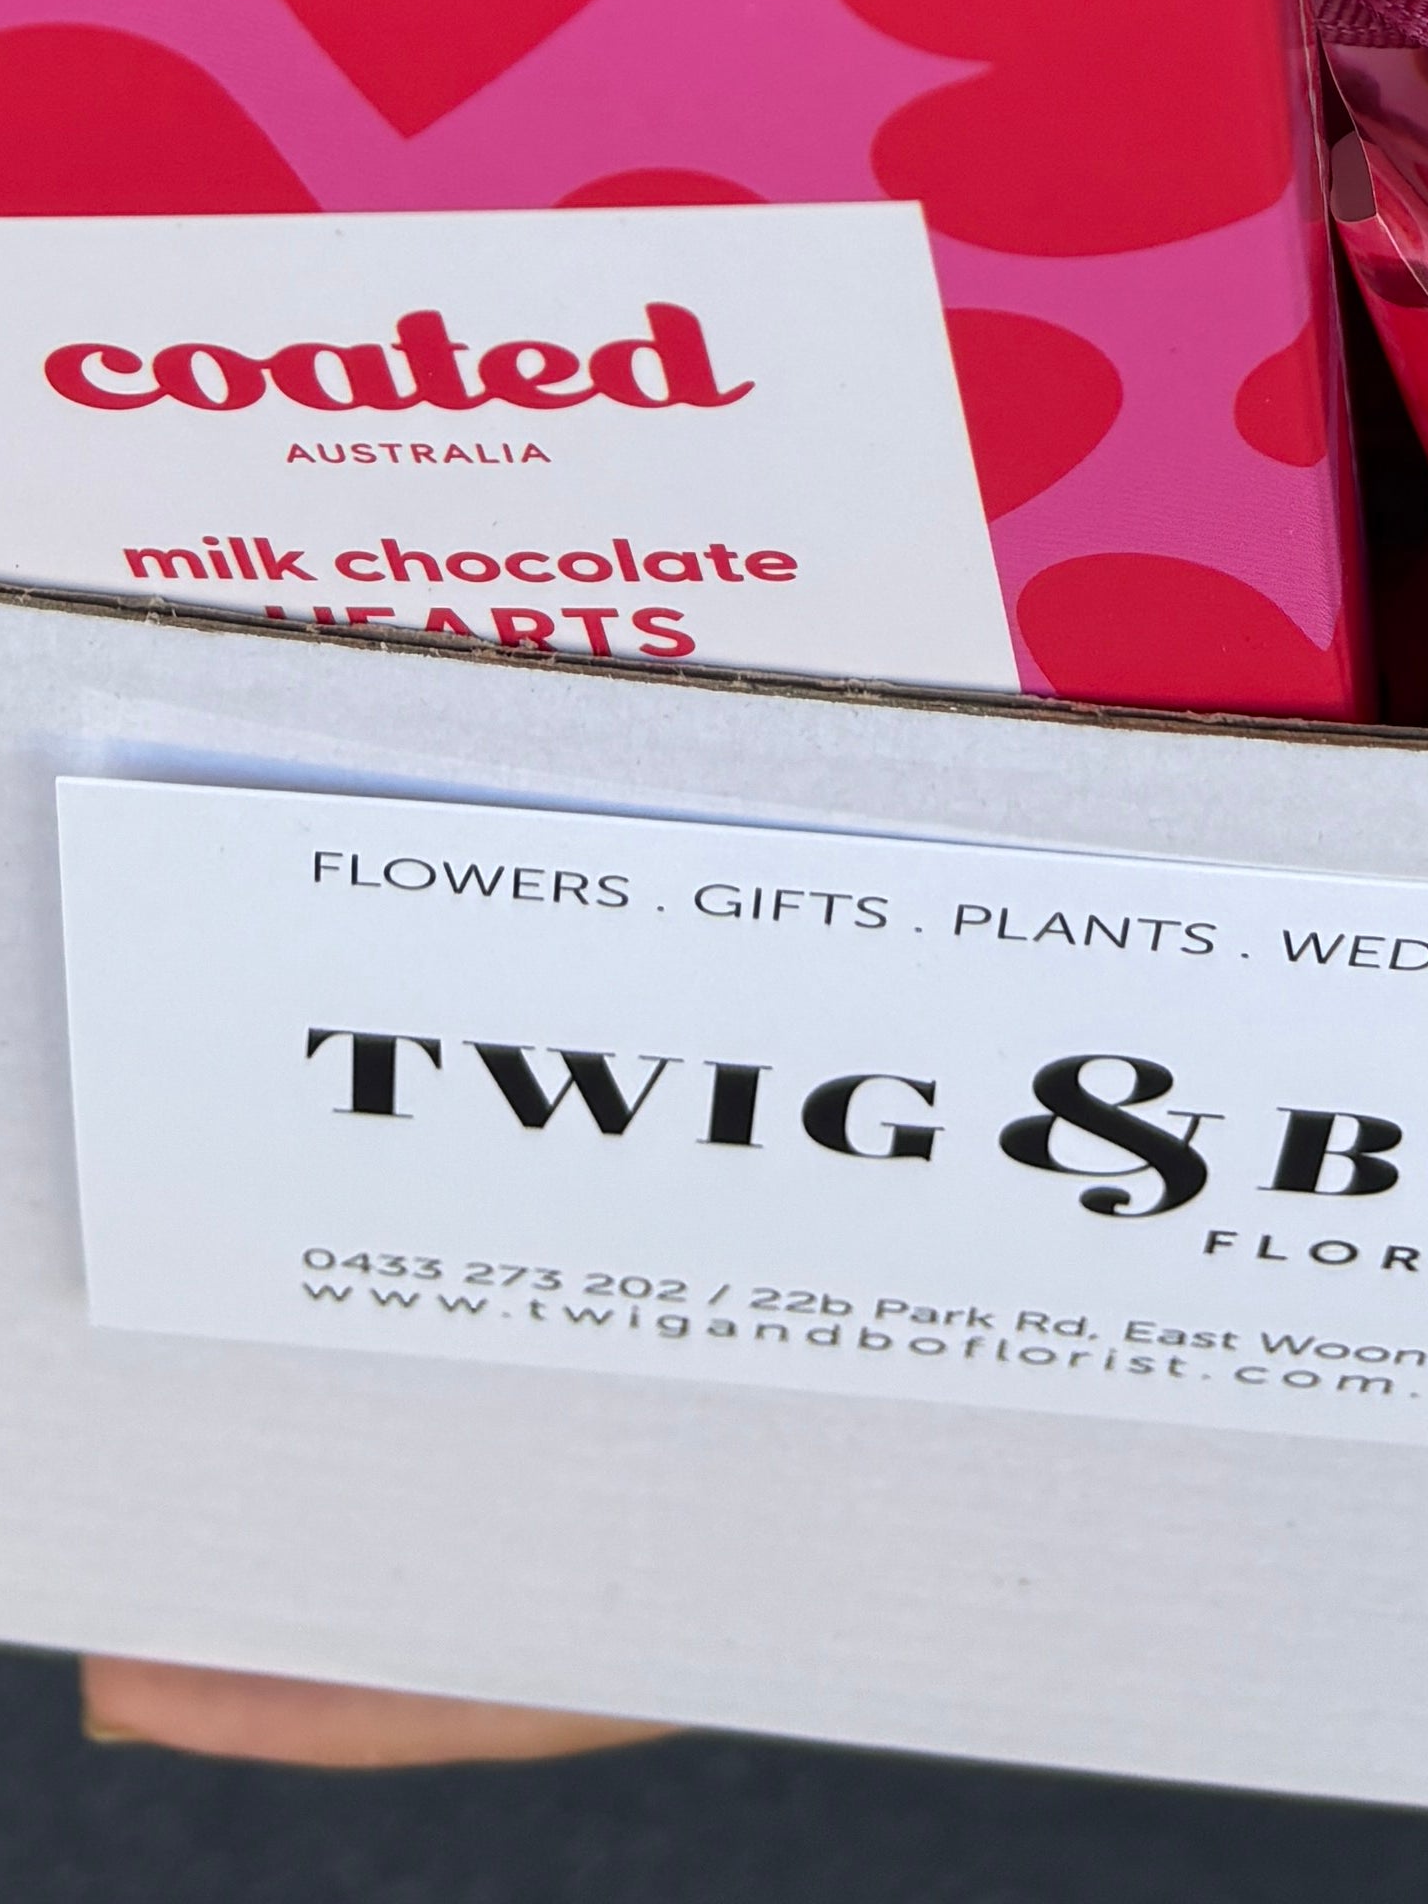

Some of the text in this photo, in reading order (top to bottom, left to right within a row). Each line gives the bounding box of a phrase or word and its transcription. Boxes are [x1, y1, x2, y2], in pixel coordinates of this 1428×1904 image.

[43, 301, 756, 411] coated
[285, 442, 551, 465] AUSTRALIA
[122, 536, 799, 583] milk chocolate
[312, 850, 630, 909] FLOWERS
[693, 883, 889, 930] GIFTS
[952, 903, 1218, 956] PLANTS
[306, 1027, 945, 1162] TWIG
[998, 1053, 1225, 1218] &
[302, 1247, 444, 1280] 0433
[463, 1261, 562, 1293] 273
[582, 1272, 688, 1305] 202
[749, 1287, 853, 1318] 22b
[874, 1298, 993, 1331] Park
[1123, 1320, 1238, 1352] East
